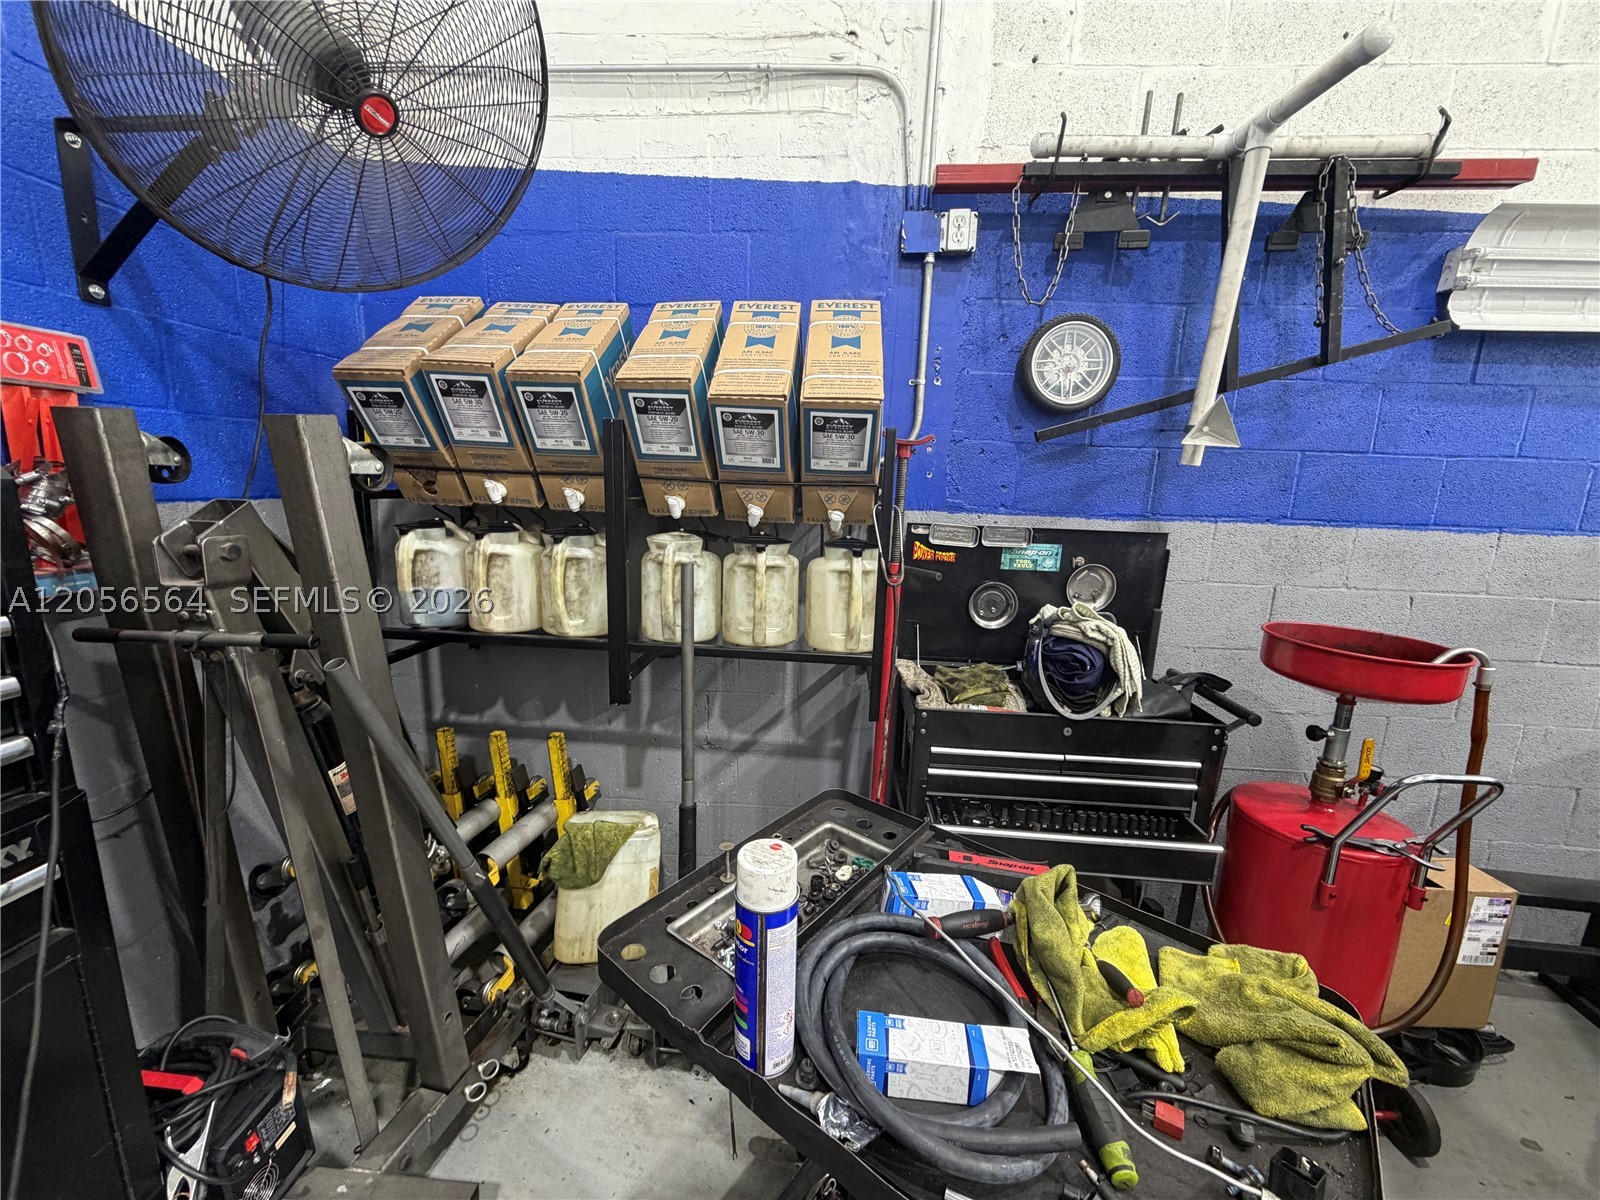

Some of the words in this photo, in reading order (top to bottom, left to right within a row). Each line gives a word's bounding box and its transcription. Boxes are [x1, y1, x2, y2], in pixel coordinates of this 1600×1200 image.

[738, 302, 795, 310] EVEREST
[913, 541, 935, 560] POWER
[1010, 547, 1053, 556] Snap-on
[987, 858, 1036, 873] Snap-on
